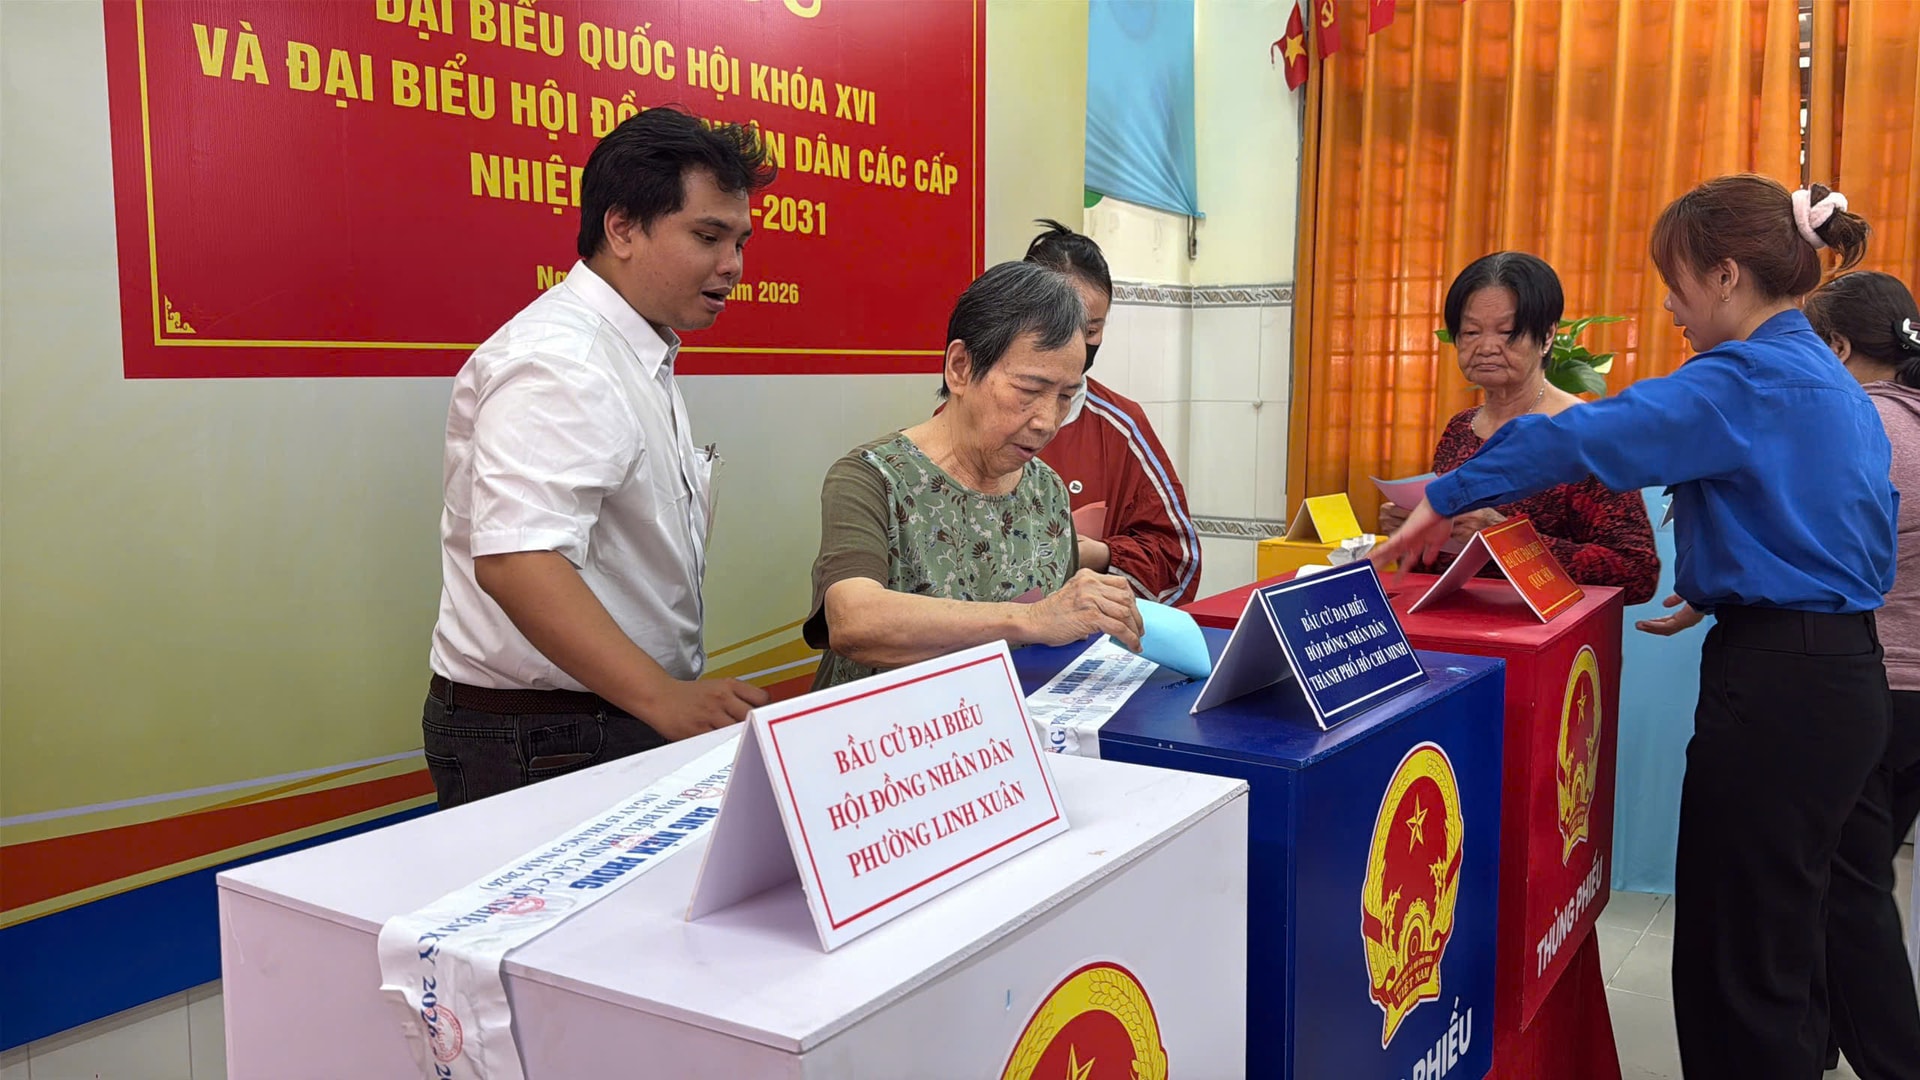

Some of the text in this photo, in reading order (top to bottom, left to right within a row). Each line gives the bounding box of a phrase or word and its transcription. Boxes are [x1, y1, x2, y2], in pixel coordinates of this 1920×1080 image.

[192, 21, 269, 85] VÀ
[286, 40, 374, 108] ĐẠI
[391, 53, 495, 120] BIỂU
[511, 79, 578, 140] HỘI
[795, 133, 850, 180] DÂN
[858, 145, 906, 188] CÁC
[914, 152, 958, 195] CẤP
[578, 22, 675, 81] QUỐC
[687, 45, 740, 101] HỘI
[750, 62, 828, 115] KHÓA
[835, 82, 876, 125] XVI
[758, 281, 799, 304] 2026
[1304, 640, 1324, 663] HỘI
[1345, 624, 1371, 647] NHÂN
[1368, 618, 1388, 638] DÂN
[1332, 605, 1349, 624] ĐẠI
[1369, 645, 1387, 667] CHÍ
[1384, 641, 1409, 661] MINH
[833, 697, 984, 775] BẦU CỬ ĐẠI BIỂU
[827, 792, 870, 831] HỘI
[869, 773, 926, 814] ĐỒNG
[926, 752, 979, 791] NHÂN
[978, 738, 1015, 772] DÂN
[847, 781, 1026, 878] PHƯỜNG LINH XUÂN
[568, 856, 648, 889] PHONG
[1536, 897, 1575, 978] THÙNG
[1574, 848, 1604, 922] PHIẾU
[1412, 997, 1473, 1080] PHIẾU
